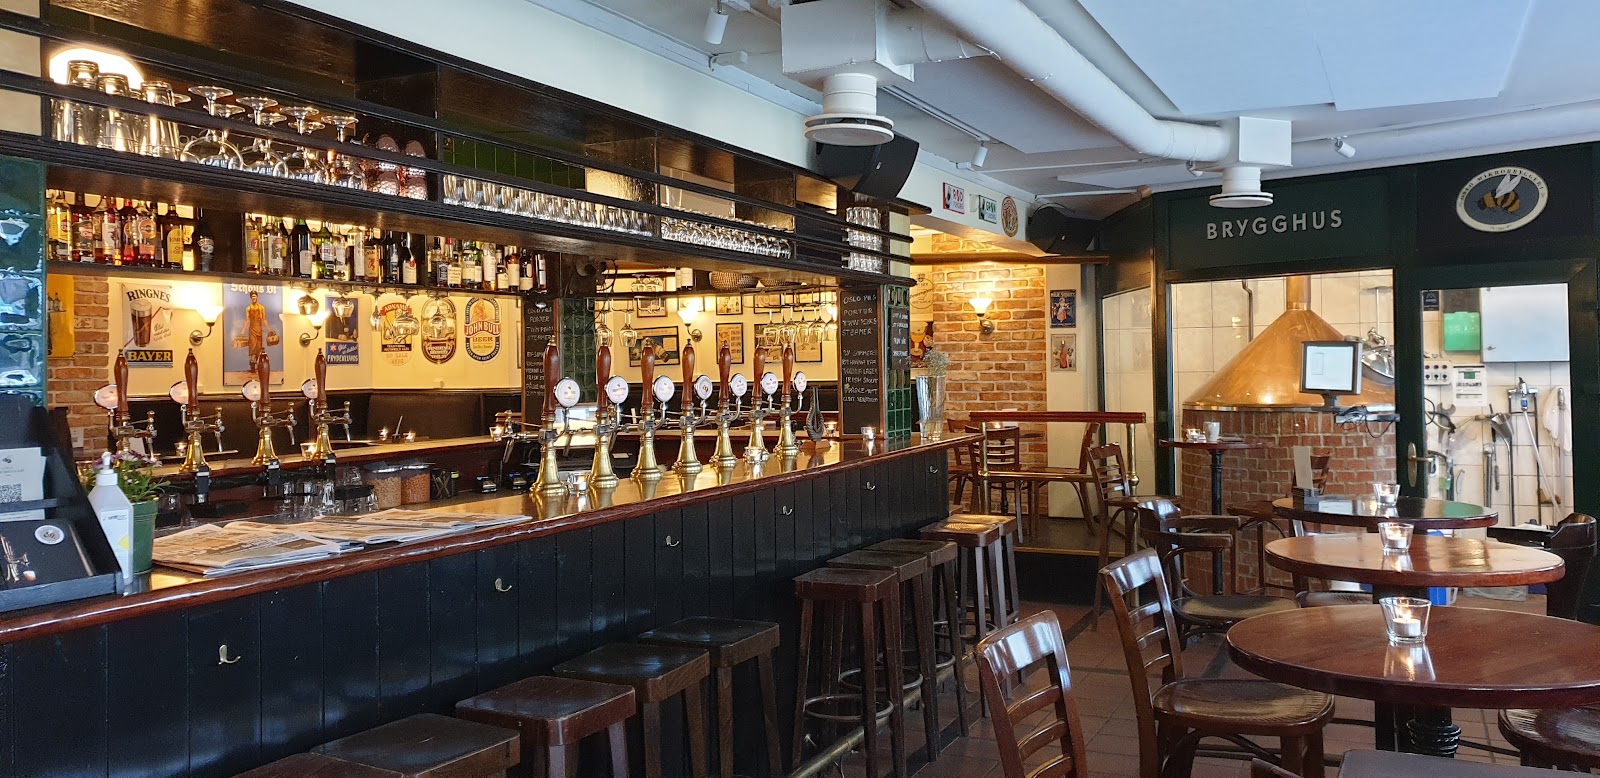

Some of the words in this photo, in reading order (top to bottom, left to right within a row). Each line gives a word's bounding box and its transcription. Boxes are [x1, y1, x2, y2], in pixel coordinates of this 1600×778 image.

[1206, 210, 1342, 240] BRYGGHUS
[127, 289, 170, 302] RINGNES
[844, 296, 861, 304] OSLO
[843, 308, 873, 316] PORTER
[466, 321, 483, 335] JOHN
[483, 321, 500, 335] BULL
[842, 328, 872, 336] STEAMER
[129, 351, 171, 361] BAYER
